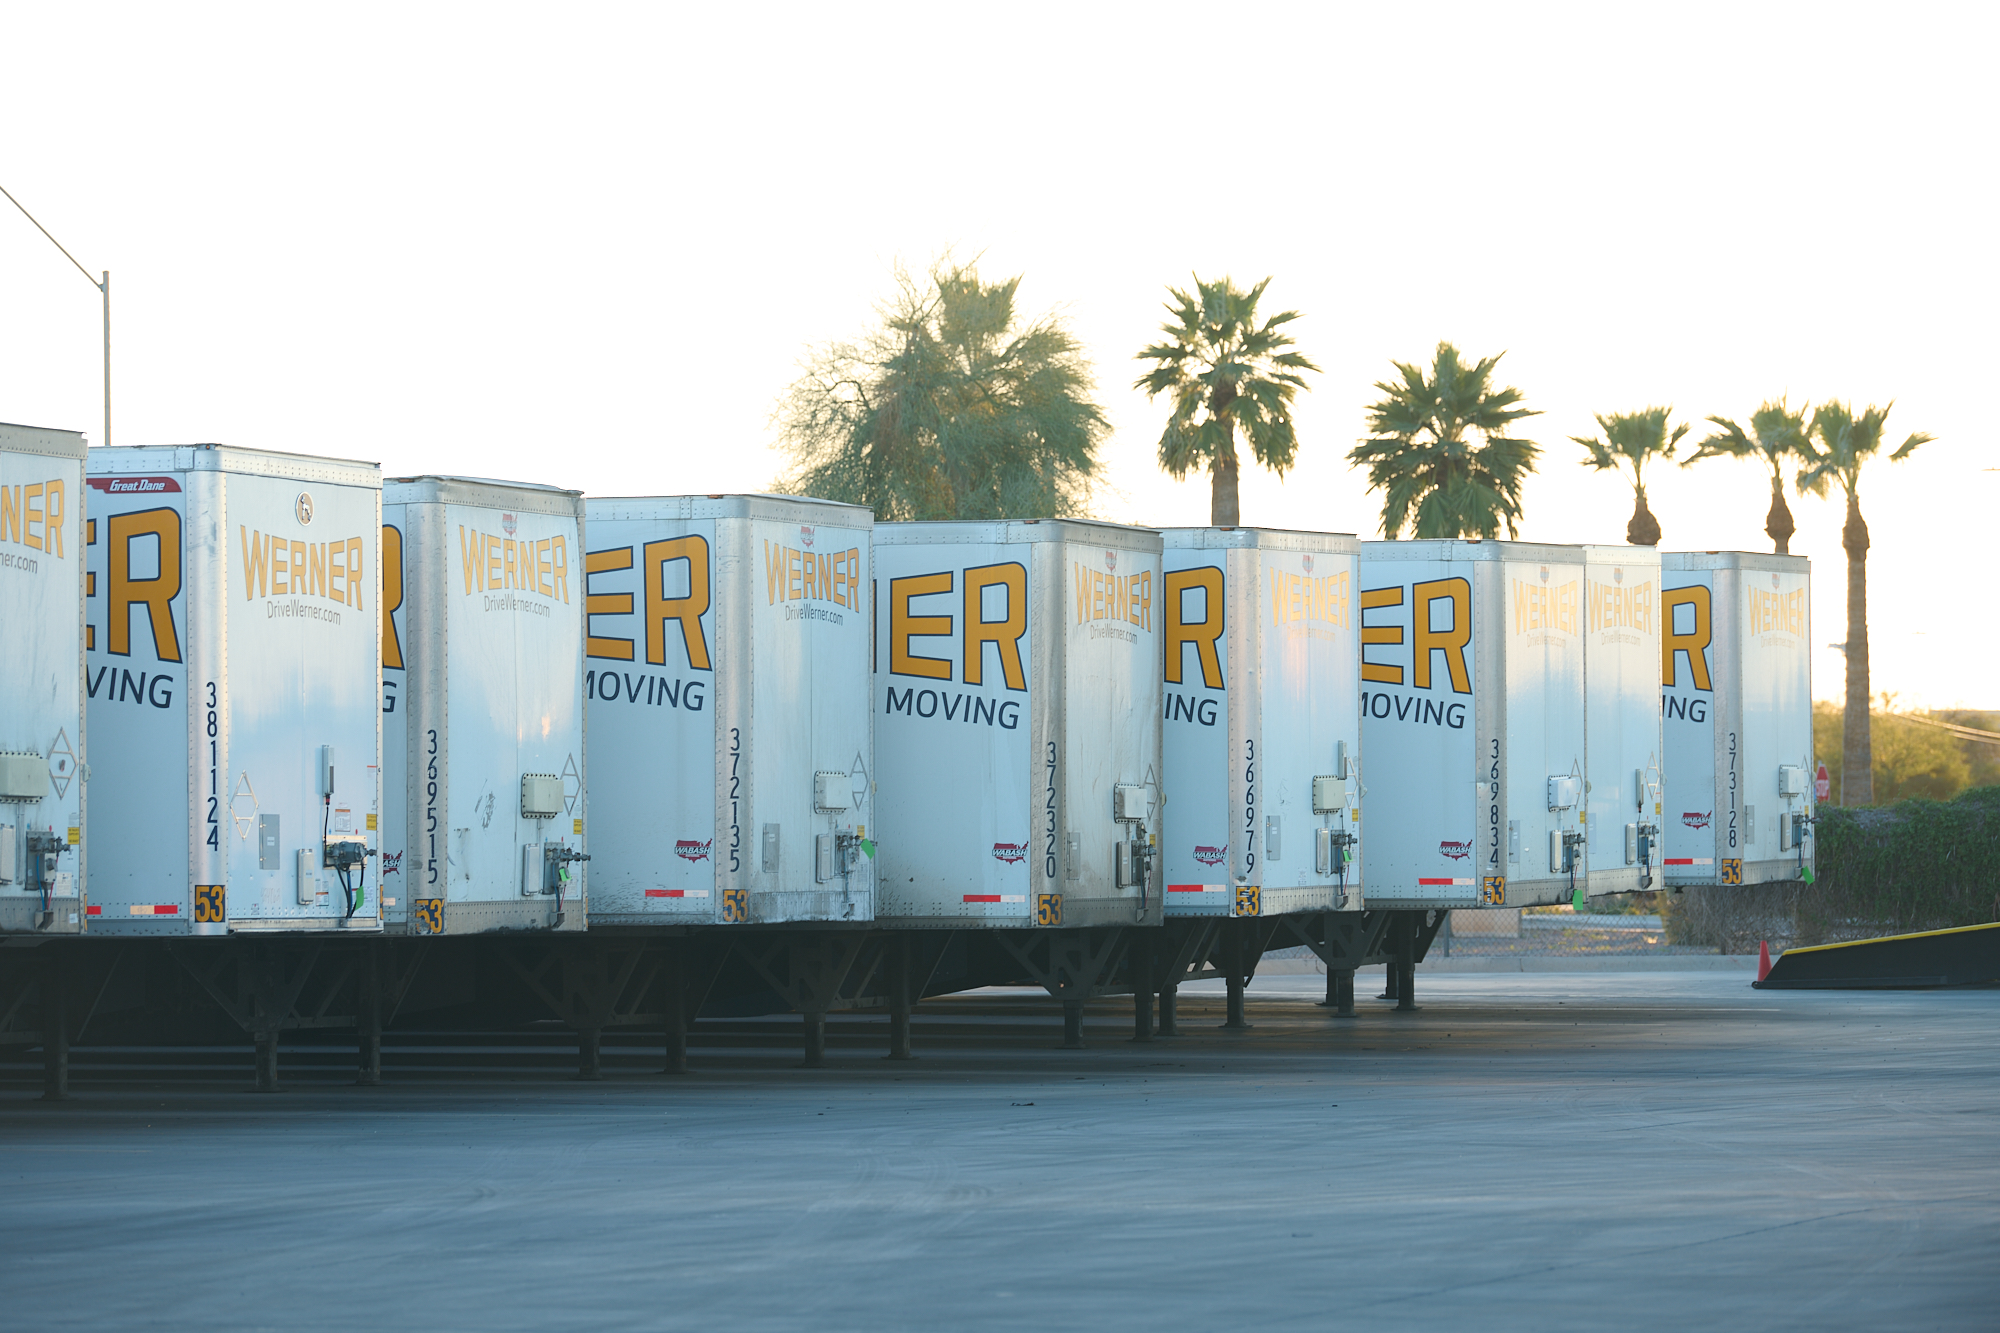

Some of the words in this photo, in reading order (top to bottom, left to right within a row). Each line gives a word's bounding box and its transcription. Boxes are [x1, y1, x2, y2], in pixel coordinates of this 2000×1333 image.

[1, 478, 64, 559] NER
[109, 479, 138, 491] Great
[138, 479, 165, 490] Dane
[87, 506, 182, 664] R
[240, 524, 362, 611] WERNER
[459, 524, 569, 605] WERNER
[764, 538, 860, 613] WERNER
[1075, 561, 1151, 633] WERNER
[1270, 566, 1350, 631] WERNER
[267, 599, 341, 625] DriveWerner.com
[484, 594, 550, 618] DriveWerner.com
[785, 603, 844, 626] DriveWerner.com
[873, 561, 1028, 692] ER
[1090, 623, 1137, 645] DriveWerner.com
[1512, 577, 1578, 637] WERNER
[1587, 578, 1652, 635] WERNER
[1748, 585, 1805, 640] WERNER
[886, 687, 1020, 730] MOVING
[205, 681, 219, 851] 381124
[729, 727, 740, 873] 372135
[1728, 732, 1737, 848] 373128
[427, 729, 438, 884] 369515
[1046, 741, 1056, 878] 372320
[1245, 739, 1255, 874] 366979
[1490, 738, 1499, 868] 369834
[674, 846, 711, 854] WABASH
[992, 849, 1028, 857] WABASH
[1193, 851, 1227, 859] WABASH
[1439, 846, 1472, 854] WABASH
